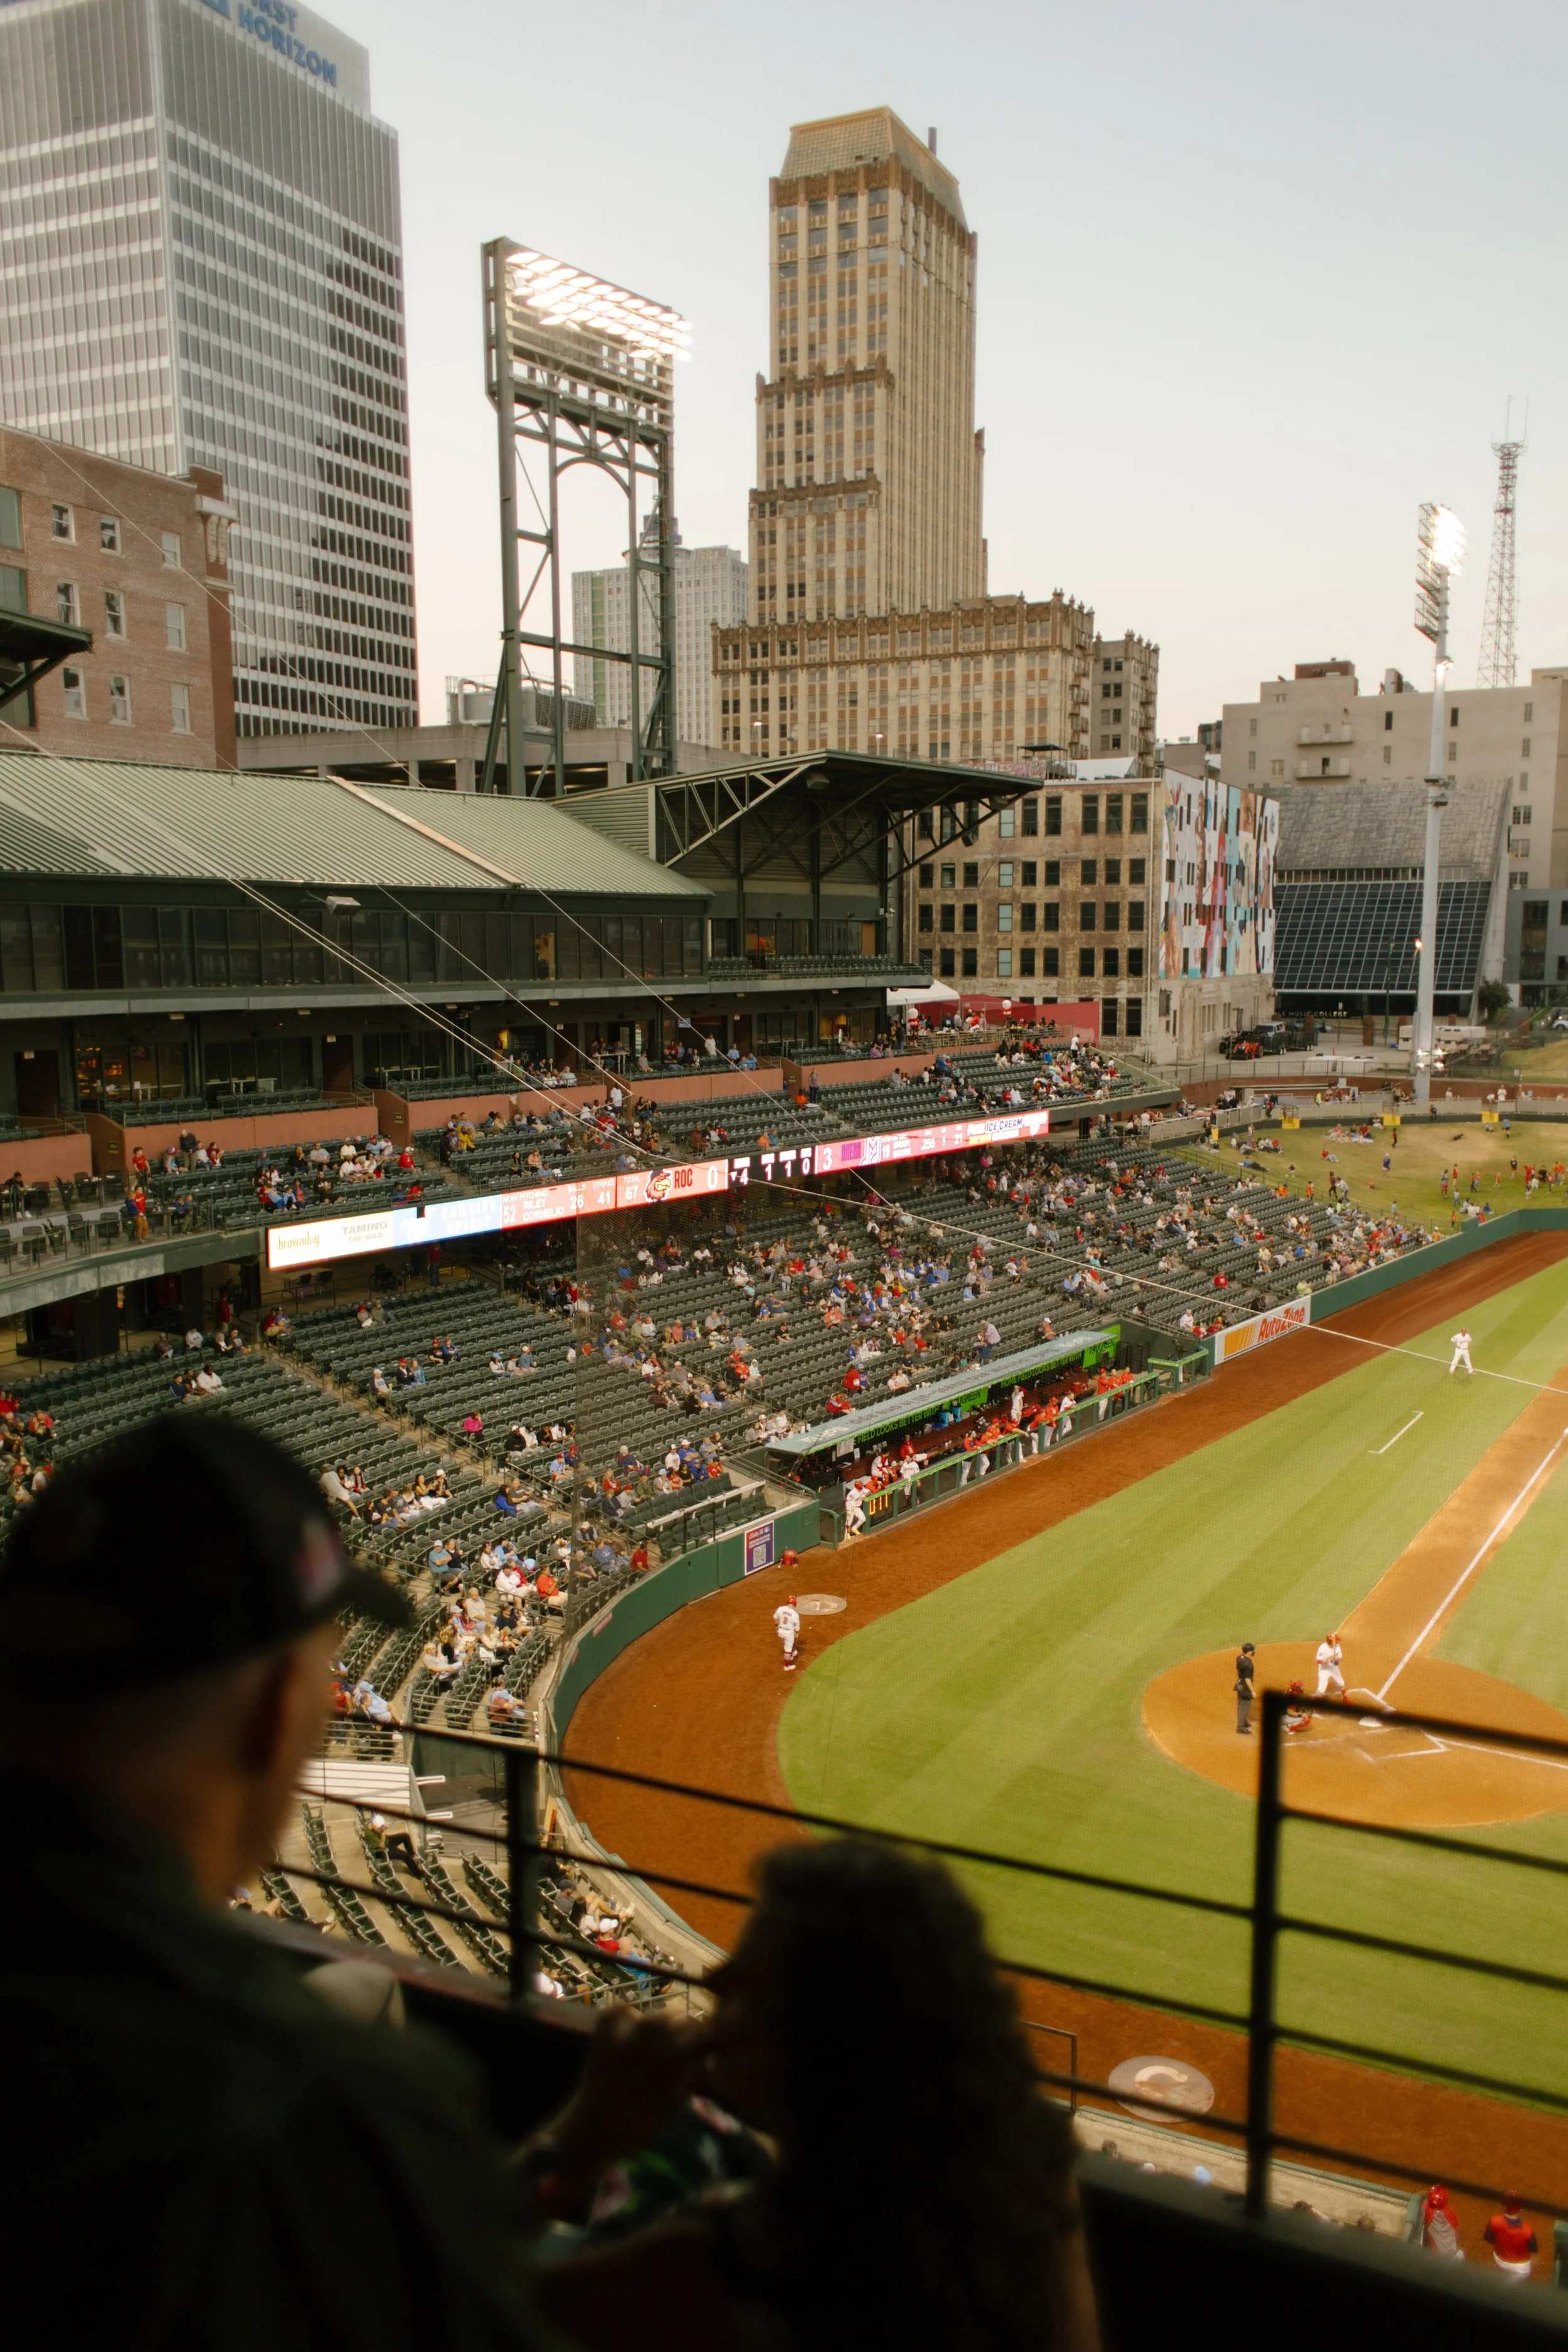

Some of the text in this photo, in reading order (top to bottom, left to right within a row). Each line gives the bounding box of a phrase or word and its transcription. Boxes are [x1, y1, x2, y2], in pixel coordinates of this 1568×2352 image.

[238, 3, 337, 87] HORIZON
[986, 1122, 997, 1131] ICE
[999, 1118, 1022, 1130] CREAM
[822, 1147, 832, 1170] 3
[841, 1142, 861, 1162] MEM
[623, 1175, 640, 1184] TOTAL
[674, 1165, 718, 1190] ROC 0
[740, 1158, 810, 1185] 4 1 1 0
[568, 1179, 615, 1193] BALLS STRIKES
[625, 1185, 639, 1200] 67
[502, 1189, 548, 1204] NOW PITCHING
[570, 1190, 610, 1210] 26 41
[503, 1198, 546, 1224] 52 RILEY
[522, 1206, 564, 1222] CORNELIO
[342, 1221, 388, 1235] TAMING
[446, 1216, 491, 1235] SPIRIT
[278, 1231, 320, 1251] browndog
[365, 1232, 383, 1241] WILD
[1256, 1306, 1306, 1343] AutoZone
[1000, 1352, 1081, 1388] HOME FIELD LOOKS BETTER WITH
[857, 1430, 876, 1444] FIELD
[876, 1422, 898, 1438] LOOKS
[899, 1413, 922, 1428] BETTER
